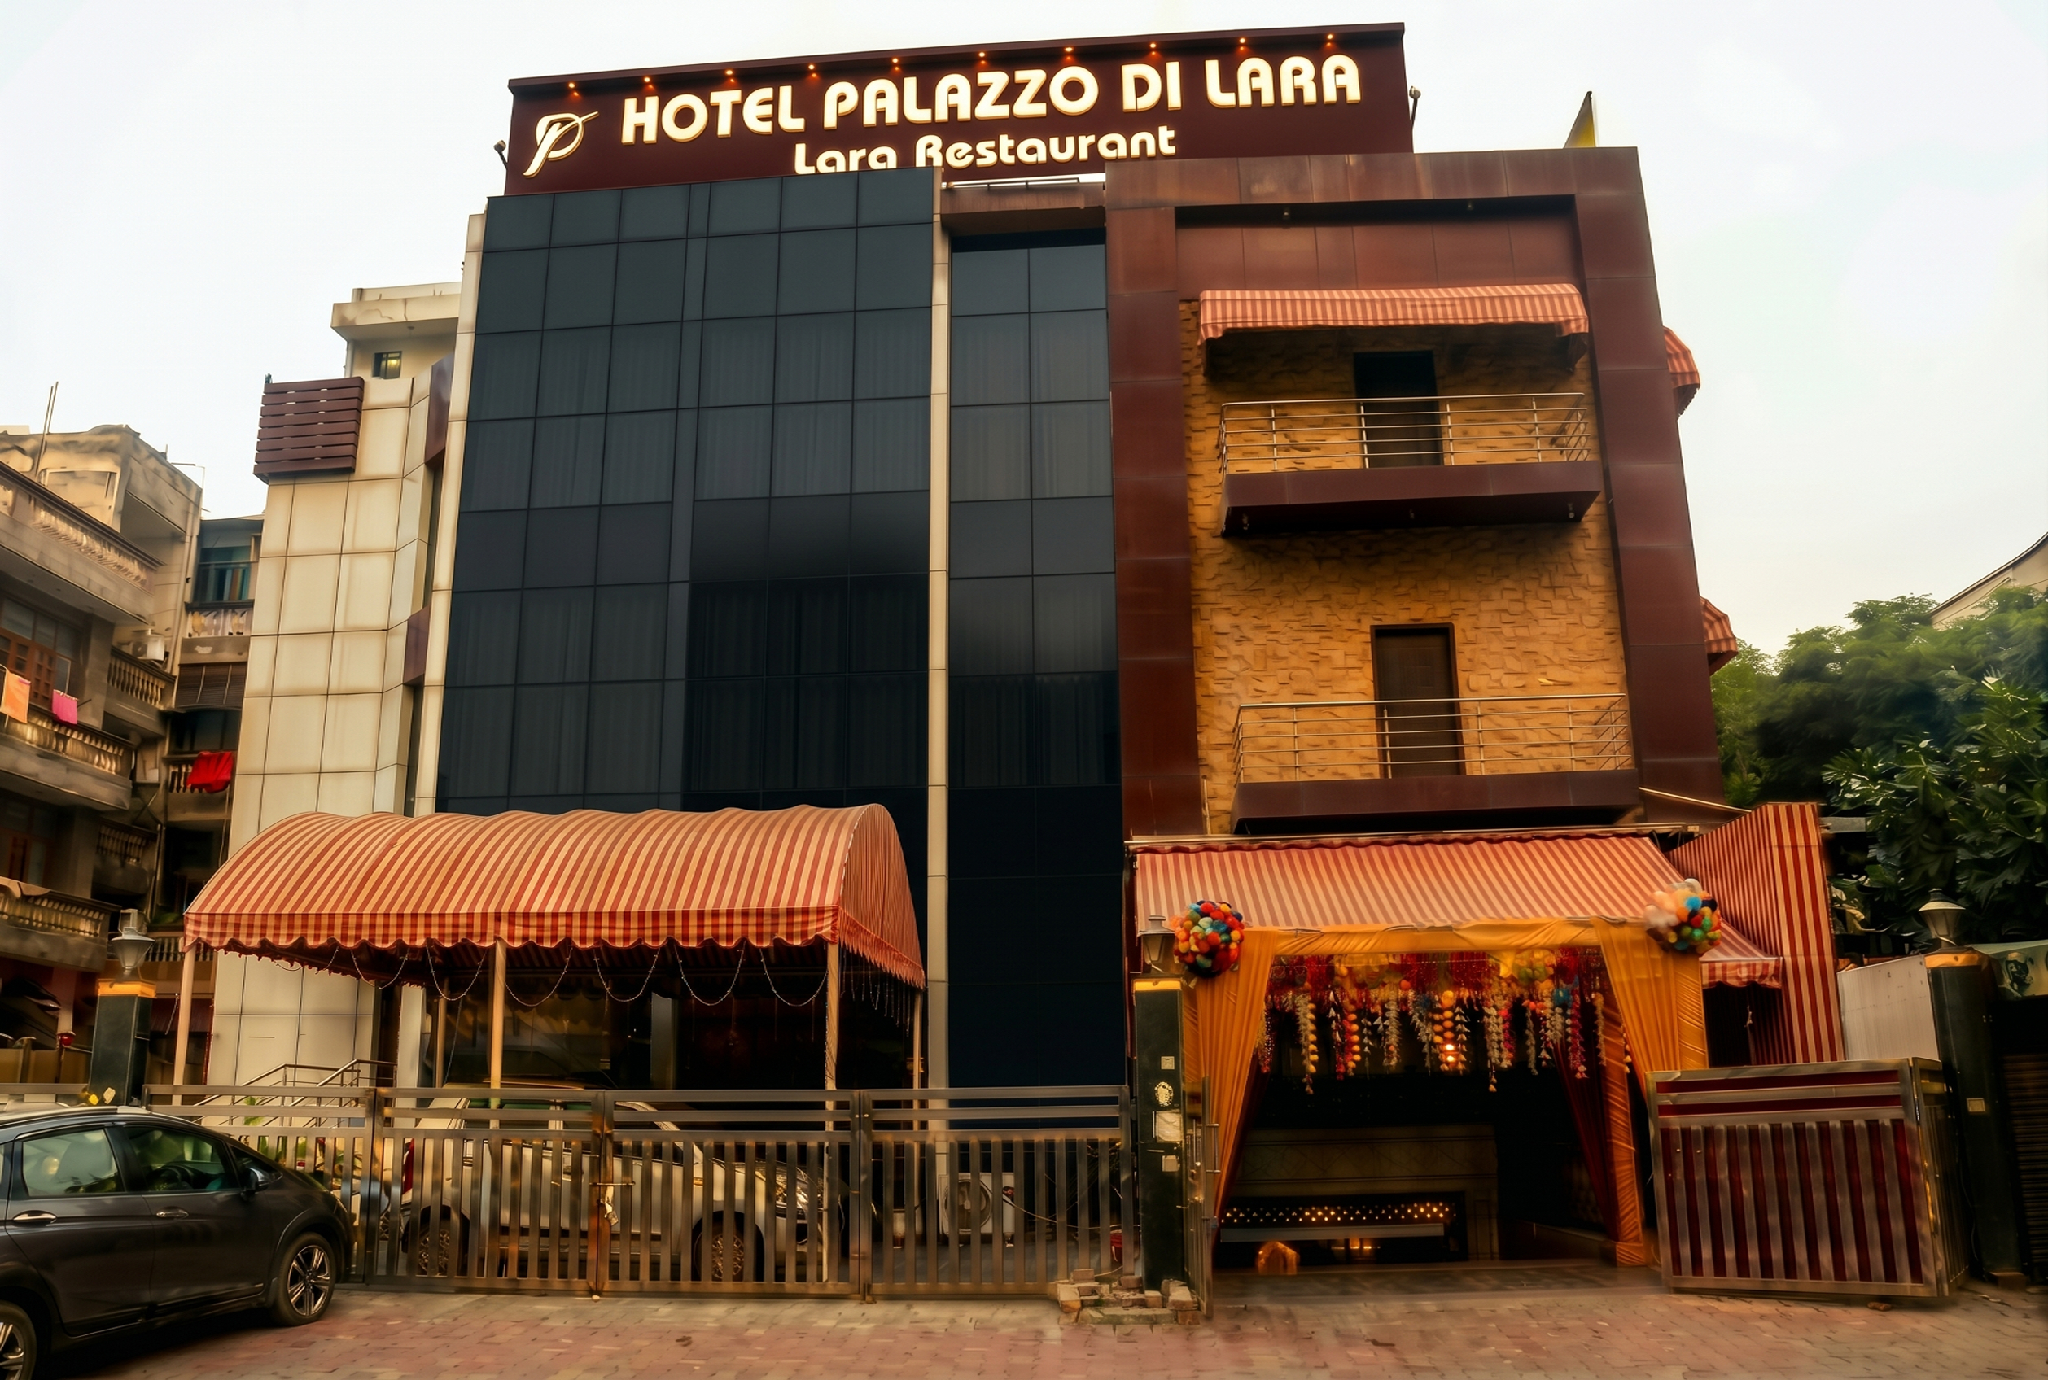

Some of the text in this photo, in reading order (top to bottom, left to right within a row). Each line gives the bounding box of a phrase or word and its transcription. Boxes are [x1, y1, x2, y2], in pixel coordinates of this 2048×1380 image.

[621, 53, 1362, 146] HOTEL PALAZZO DI LARA
[793, 125, 1177, 175] Lara Restaurant
